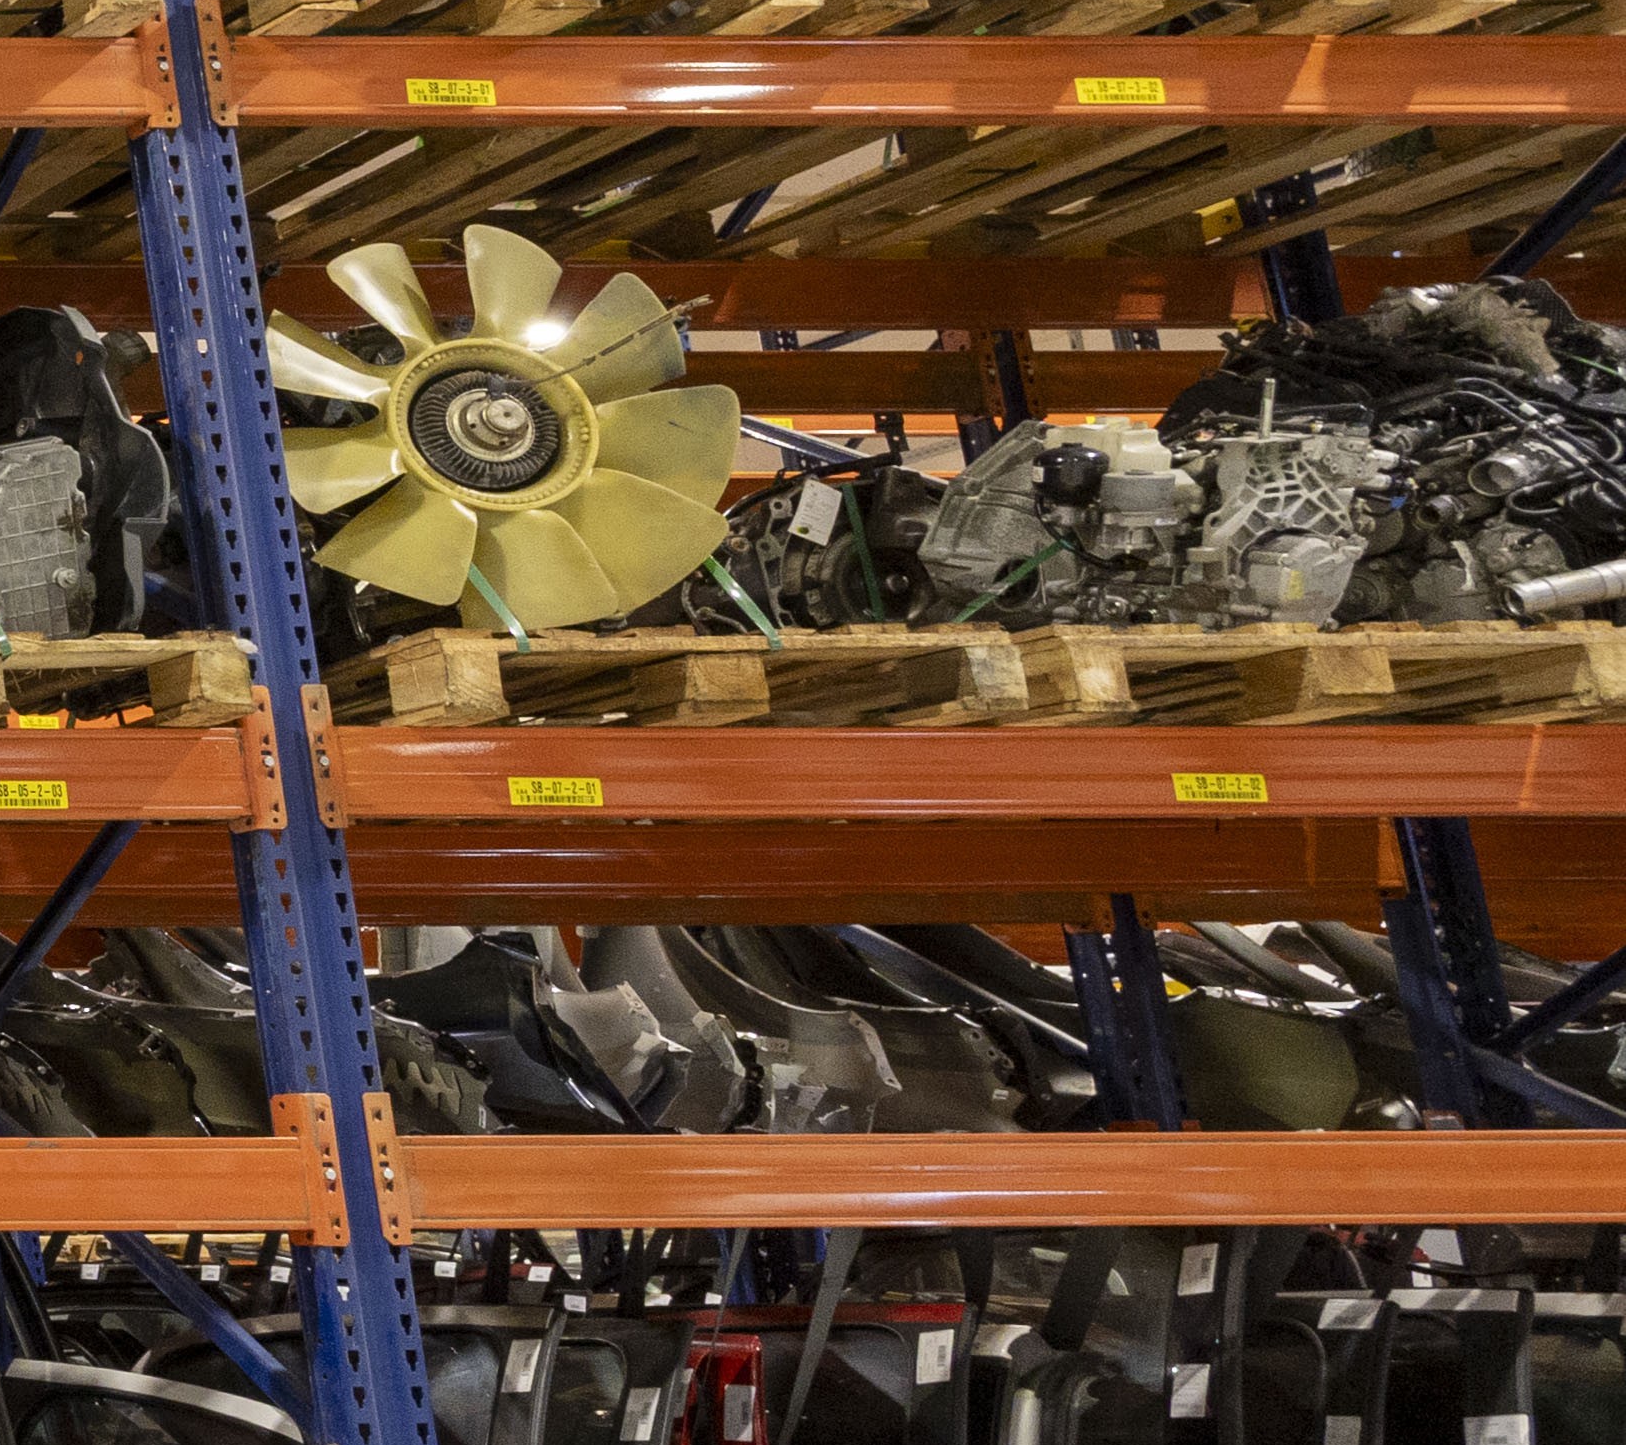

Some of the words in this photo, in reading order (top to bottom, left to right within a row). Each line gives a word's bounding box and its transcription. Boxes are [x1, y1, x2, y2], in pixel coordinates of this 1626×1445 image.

[428, 82, 490, 95] SB-07-3-01
[1098, 80, 1160, 94] SB-07-3-02
[530, 781, 596, 795] SB-07-2-01
[1196, 776, 1262, 791] SB-07-2-02
